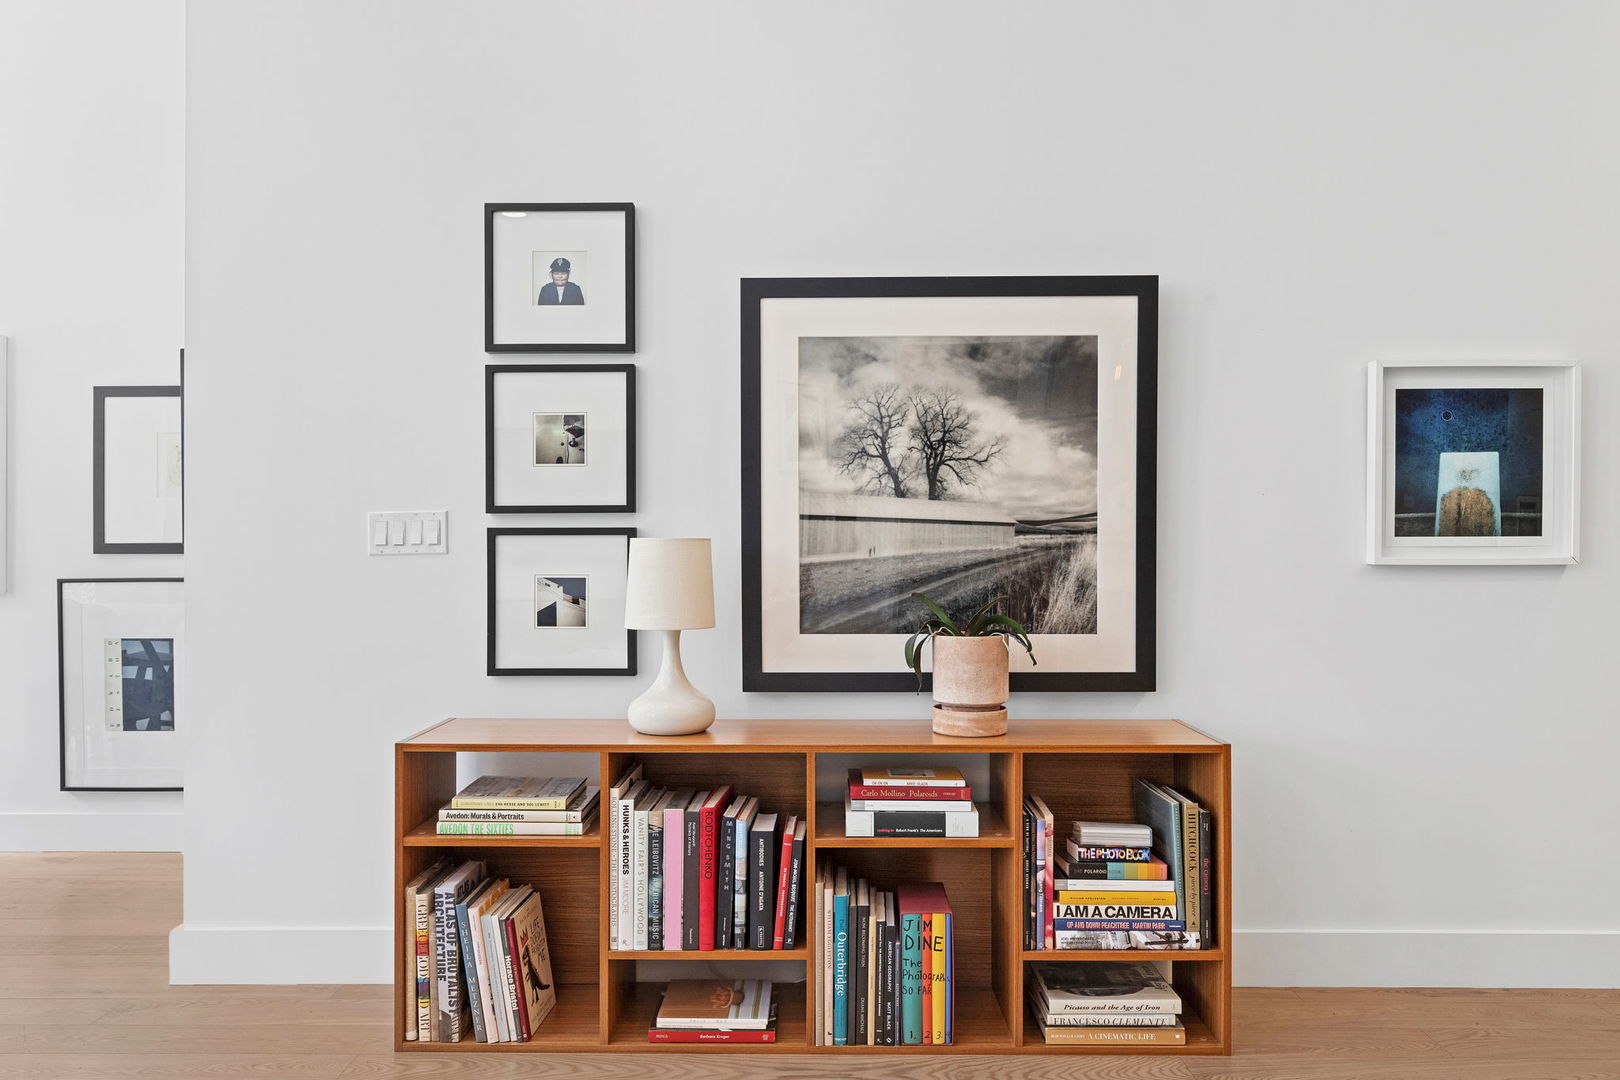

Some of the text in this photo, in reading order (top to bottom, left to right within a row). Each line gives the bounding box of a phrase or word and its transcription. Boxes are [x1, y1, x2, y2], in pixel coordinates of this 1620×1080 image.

[860, 789, 879, 798] Carlo
[879, 789, 906, 798] Mollino
[909, 789, 938, 798] Polaroids
[439, 823, 514, 834] AVEDON THE SIXTIES
[445, 812, 525, 820] Avedon: Murals & Portraits
[622, 805, 630, 834] HUNKS
[610, 830, 618, 853] STONE
[637, 817, 645, 846] VANITY
[704, 811, 714, 880] RODTCHENKO
[1188, 813, 1197, 873] HITCHCOCK
[610, 858, 618, 873] THE
[622, 841, 630, 876] HEROES
[652, 839, 660, 875] LEIBOVITZ
[723, 820, 734, 891] MING SMITH
[610, 874, 618, 927] PHOTOGRAPHS
[637, 880, 645, 935] HOLLYWOOD
[652, 877, 660, 914] AMERICAN
[1188, 892, 1196, 900] by
[1189, 900, 1197, 917] piece
[1056, 905, 1174, 919] I AM A CAMERA
[435, 892, 446, 982] ARCHITECTURE
[652, 916, 660, 940] MUSIC
[445, 892, 459, 1015] ATLAS OF BRUTALIST
[835, 931, 848, 997] Outerbridge
[902, 958, 922, 968] The
[461, 921, 473, 968] SHEILA
[468, 976, 484, 1032] METZNER
[504, 955, 514, 984] Horace
[509, 983, 519, 1011] Bristol
[1053, 1017, 1169, 1026] FRANCESCO CLEMENTE
[1063, 1003, 1161, 1012] Picasso and the Age of Iron
[1088, 1033, 1094, 1041] A
[1094, 1033, 1137, 1041] CINEMATIC
[1138, 1033, 1156, 1041] LIFE
